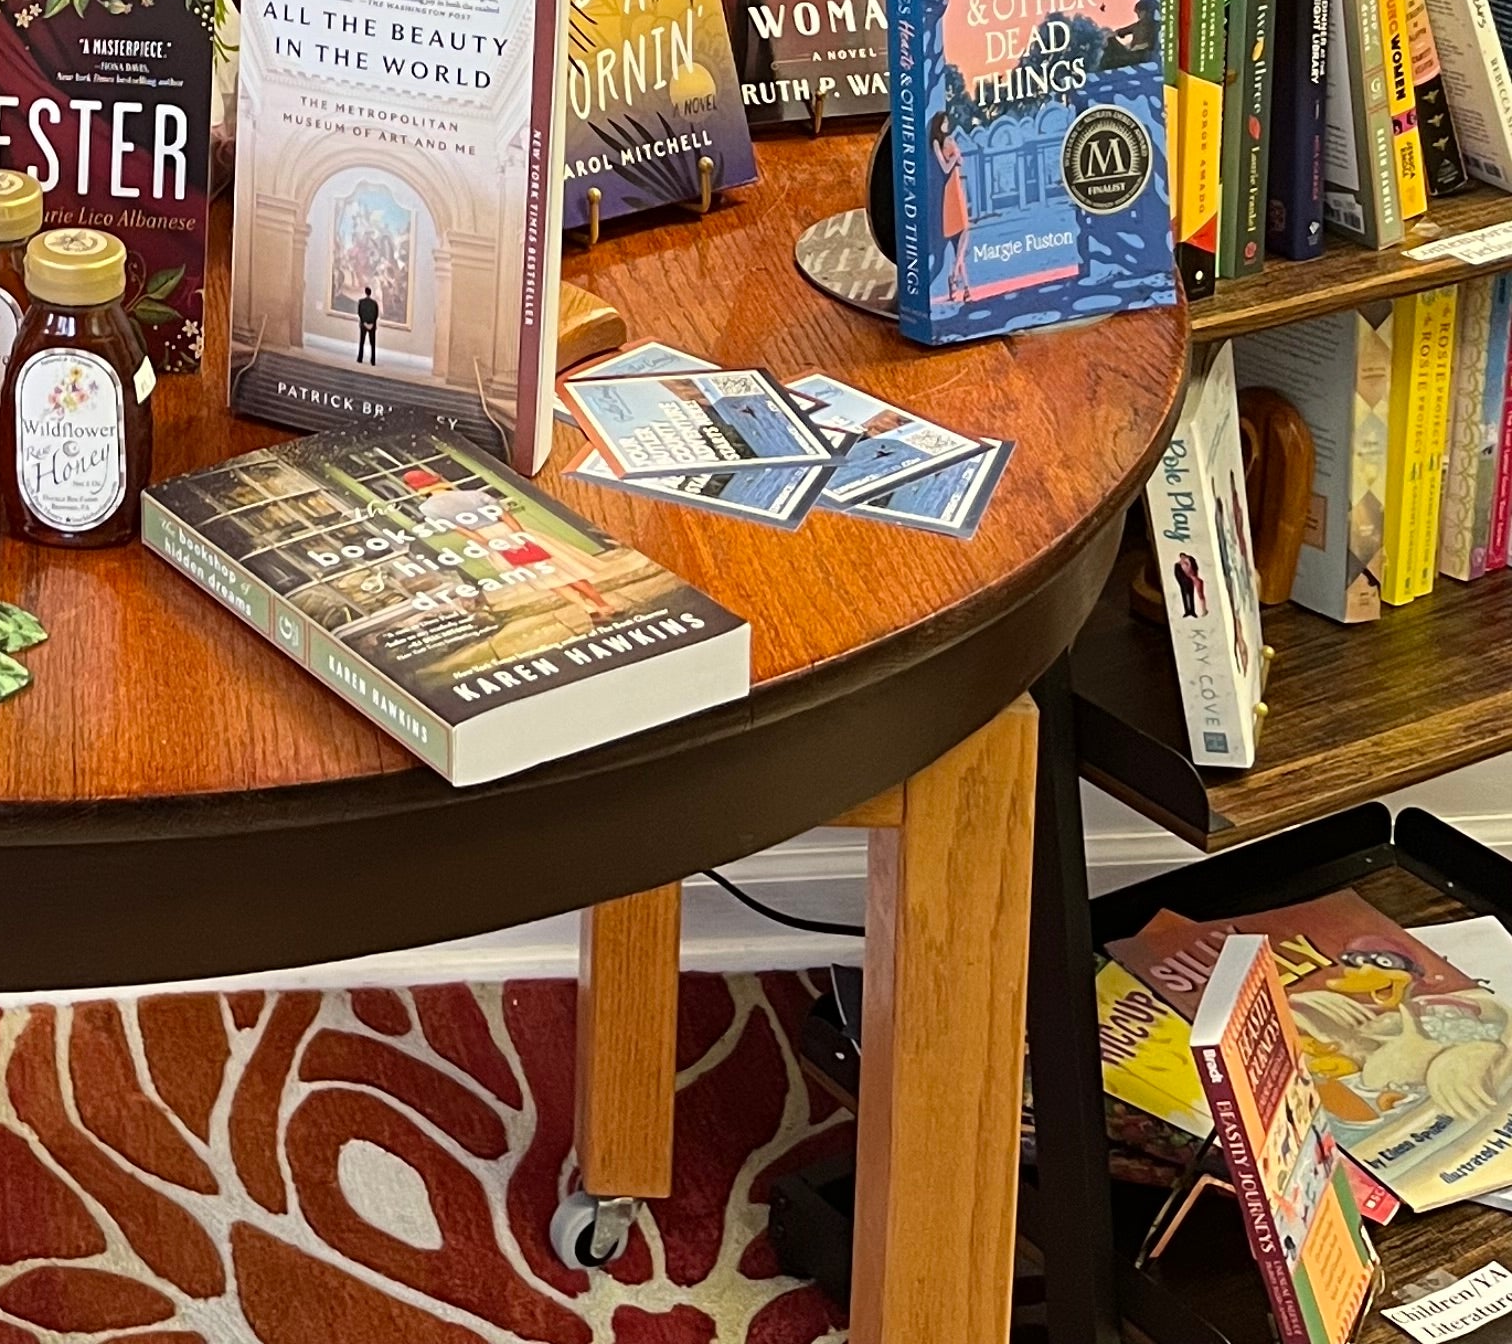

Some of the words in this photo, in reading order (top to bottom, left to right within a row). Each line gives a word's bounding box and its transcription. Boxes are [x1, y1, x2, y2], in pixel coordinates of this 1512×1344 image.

[264, 1, 310, 25] ALL
[323, 11, 376, 36] THE
[391, 23, 508, 56] BEAUTY
[899, 20, 915, 70] Hearts
[985, 21, 1070, 65] DEAD
[276, 37, 302, 58] IN
[315, 44, 368, 70] THE
[383, 56, 491, 89] WORLD
[973, 58, 1087, 108] THINGS
[1310, 33, 1322, 84] LIBRARY
[1390, 36, 1406, 101] WOMEN
[300, 96, 328, 110] THE
[336, 103, 458, 132] METROPOLITAN
[742, 80, 810, 105] RUTH
[818, 77, 840, 98] P.
[283, 113, 345, 133] MUSEUM
[353, 126, 372, 137] OF
[379, 130, 408, 144] ART
[415, 138, 447, 151] AND
[455, 144, 476, 155] ME
[900, 89, 915, 154] OTHER
[563, 153, 612, 179] AROL
[620, 128, 713, 167] MITCHELL
[1087, 138, 1127, 177] M
[903, 160, 917, 218] DEAD
[1088, 182, 1126, 195] FINALIST
[78, 207, 113, 227] Lico
[117, 210, 196, 230] Albanese
[904, 224, 918, 295] THINGS
[973, 241, 1022, 262] Margie
[1025, 232, 1073, 252] Fuston
[277, 381, 353, 412] PATRICK
[23, 419, 115, 438] Wildflower
[34, 444, 110, 494] Honey
[309, 501, 504, 570] bookshop
[412, 559, 554, 612] dreams
[452, 657, 559, 702] KAREN
[564, 612, 705, 665] HAWKINS
[1190, 629, 1208, 665] KAY
[1199, 674, 1221, 727] COVE
[1390, 1267, 1508, 1325] Children/YA
